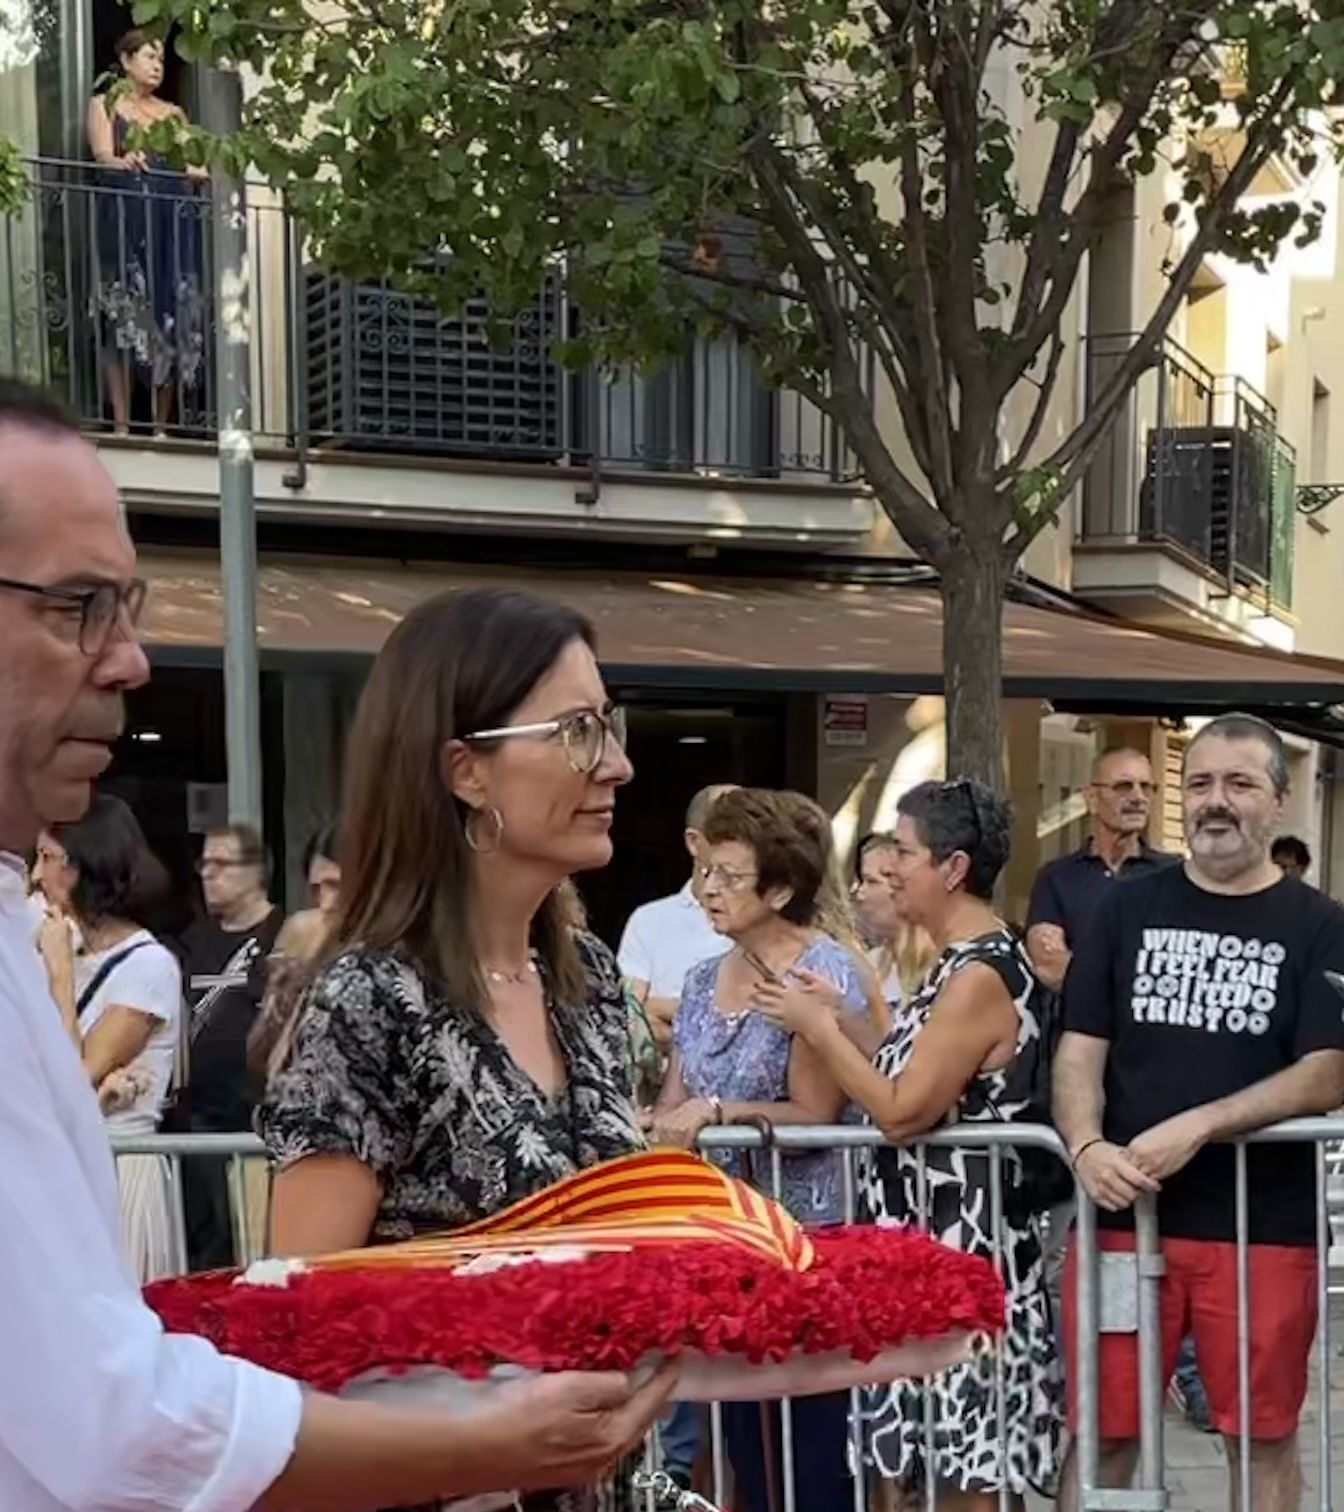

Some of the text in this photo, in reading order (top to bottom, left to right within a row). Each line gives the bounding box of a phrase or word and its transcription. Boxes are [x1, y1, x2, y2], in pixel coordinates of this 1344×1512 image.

[1142, 928, 1219, 958] WHEN
[1136, 949, 1280, 990] I FEEL FEAR
[1130, 996, 1224, 1033] TRUST
